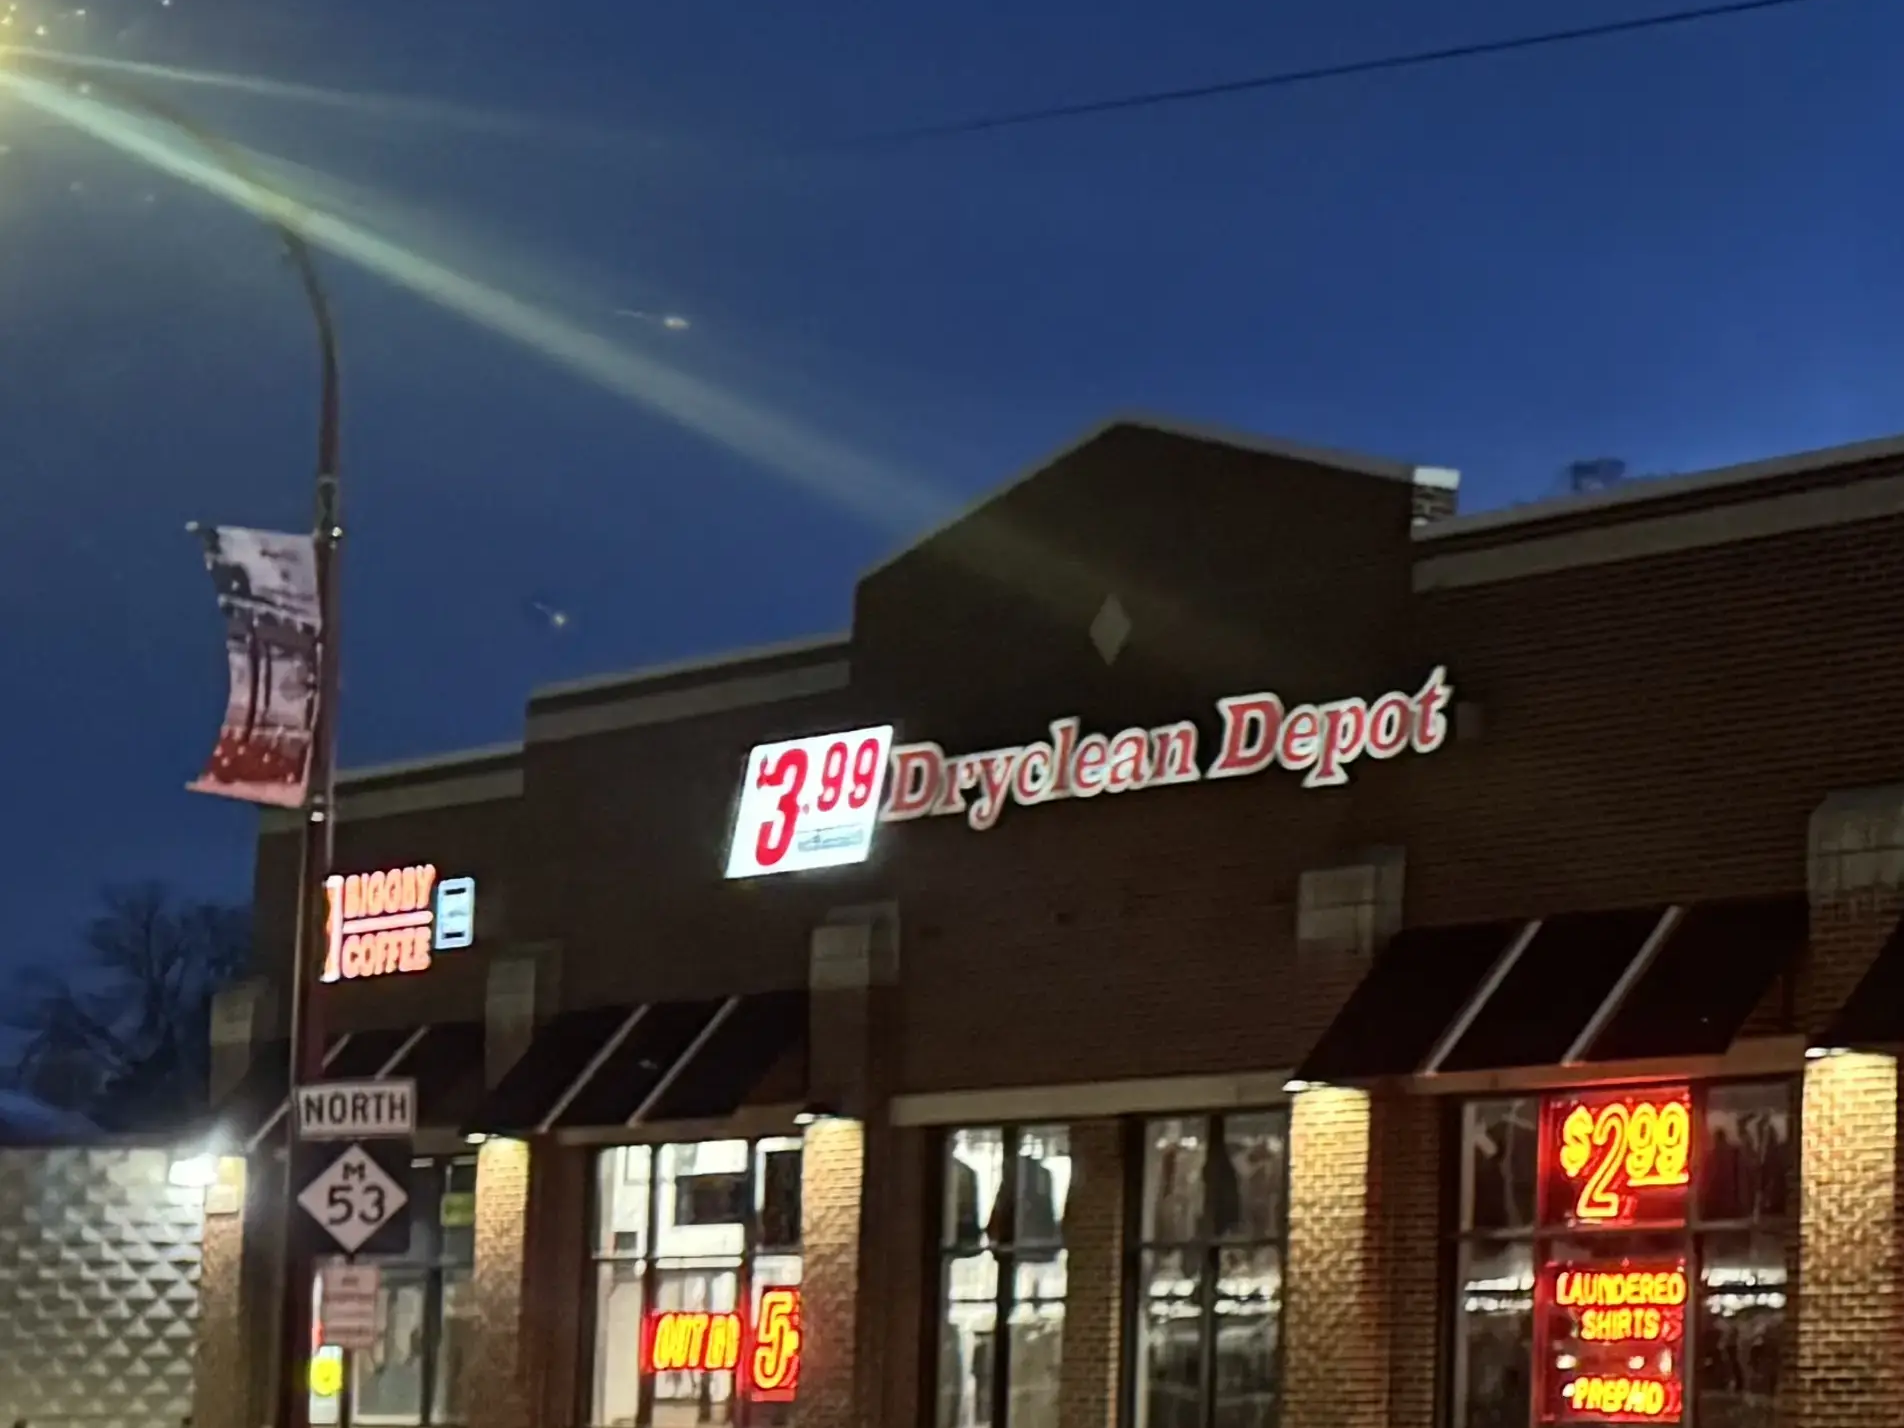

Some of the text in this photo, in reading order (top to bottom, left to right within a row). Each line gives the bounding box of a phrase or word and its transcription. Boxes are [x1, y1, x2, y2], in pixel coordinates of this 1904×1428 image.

[879, 665, 1453, 830] Dryclean Depot
[342, 926, 432, 979] COFFEE
[304, 1091, 408, 1125] NORTH
[342, 1161, 366, 1181] M
[326, 1184, 386, 1225] 53
[1555, 1271, 1687, 1306] LAUNDERED
[1580, 1307, 1661, 1341] SHIRTS
[1571, 1376, 1665, 1415] PREPAID
